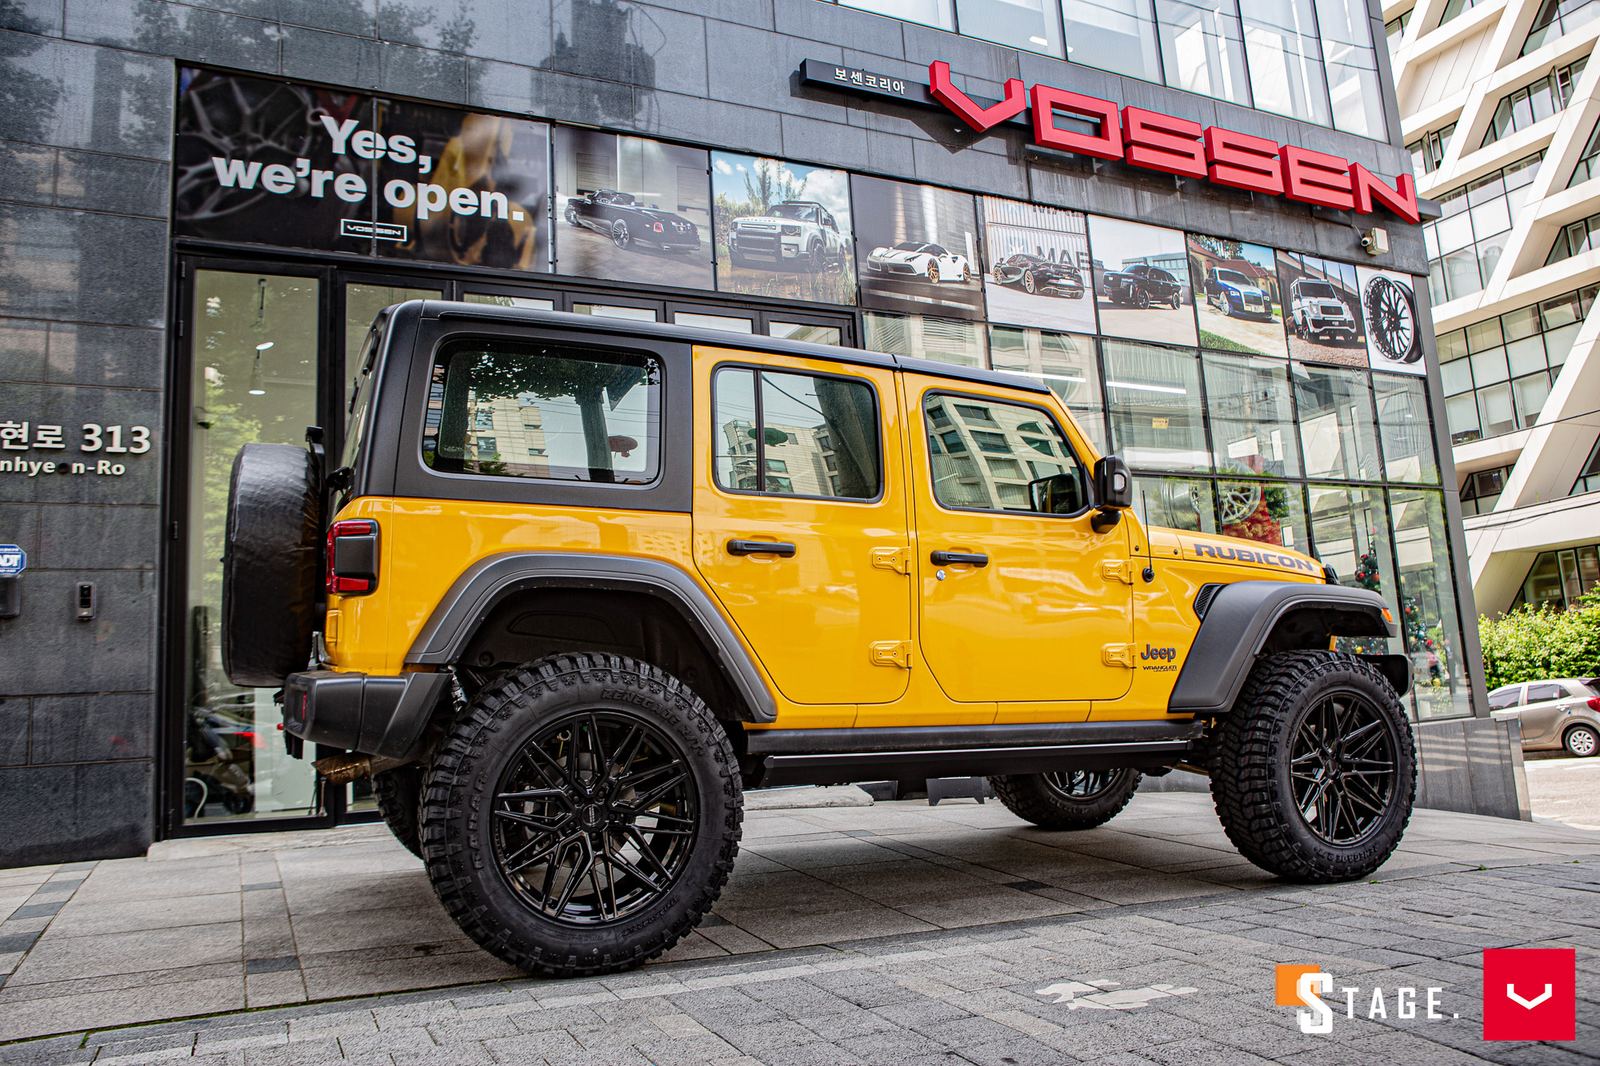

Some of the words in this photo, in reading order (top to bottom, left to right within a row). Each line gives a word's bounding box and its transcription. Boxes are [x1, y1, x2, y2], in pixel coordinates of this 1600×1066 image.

[834, 67, 905, 95] 보센코리아
[320, 115, 432, 174] Yes,
[929, 60, 1420, 224] VOSSEN
[383, 178, 525, 222] open.
[80, 423, 151, 454] 313
[1194, 543, 1314, 571] RUBICON
[1140, 643, 1177, 663] Jeep
